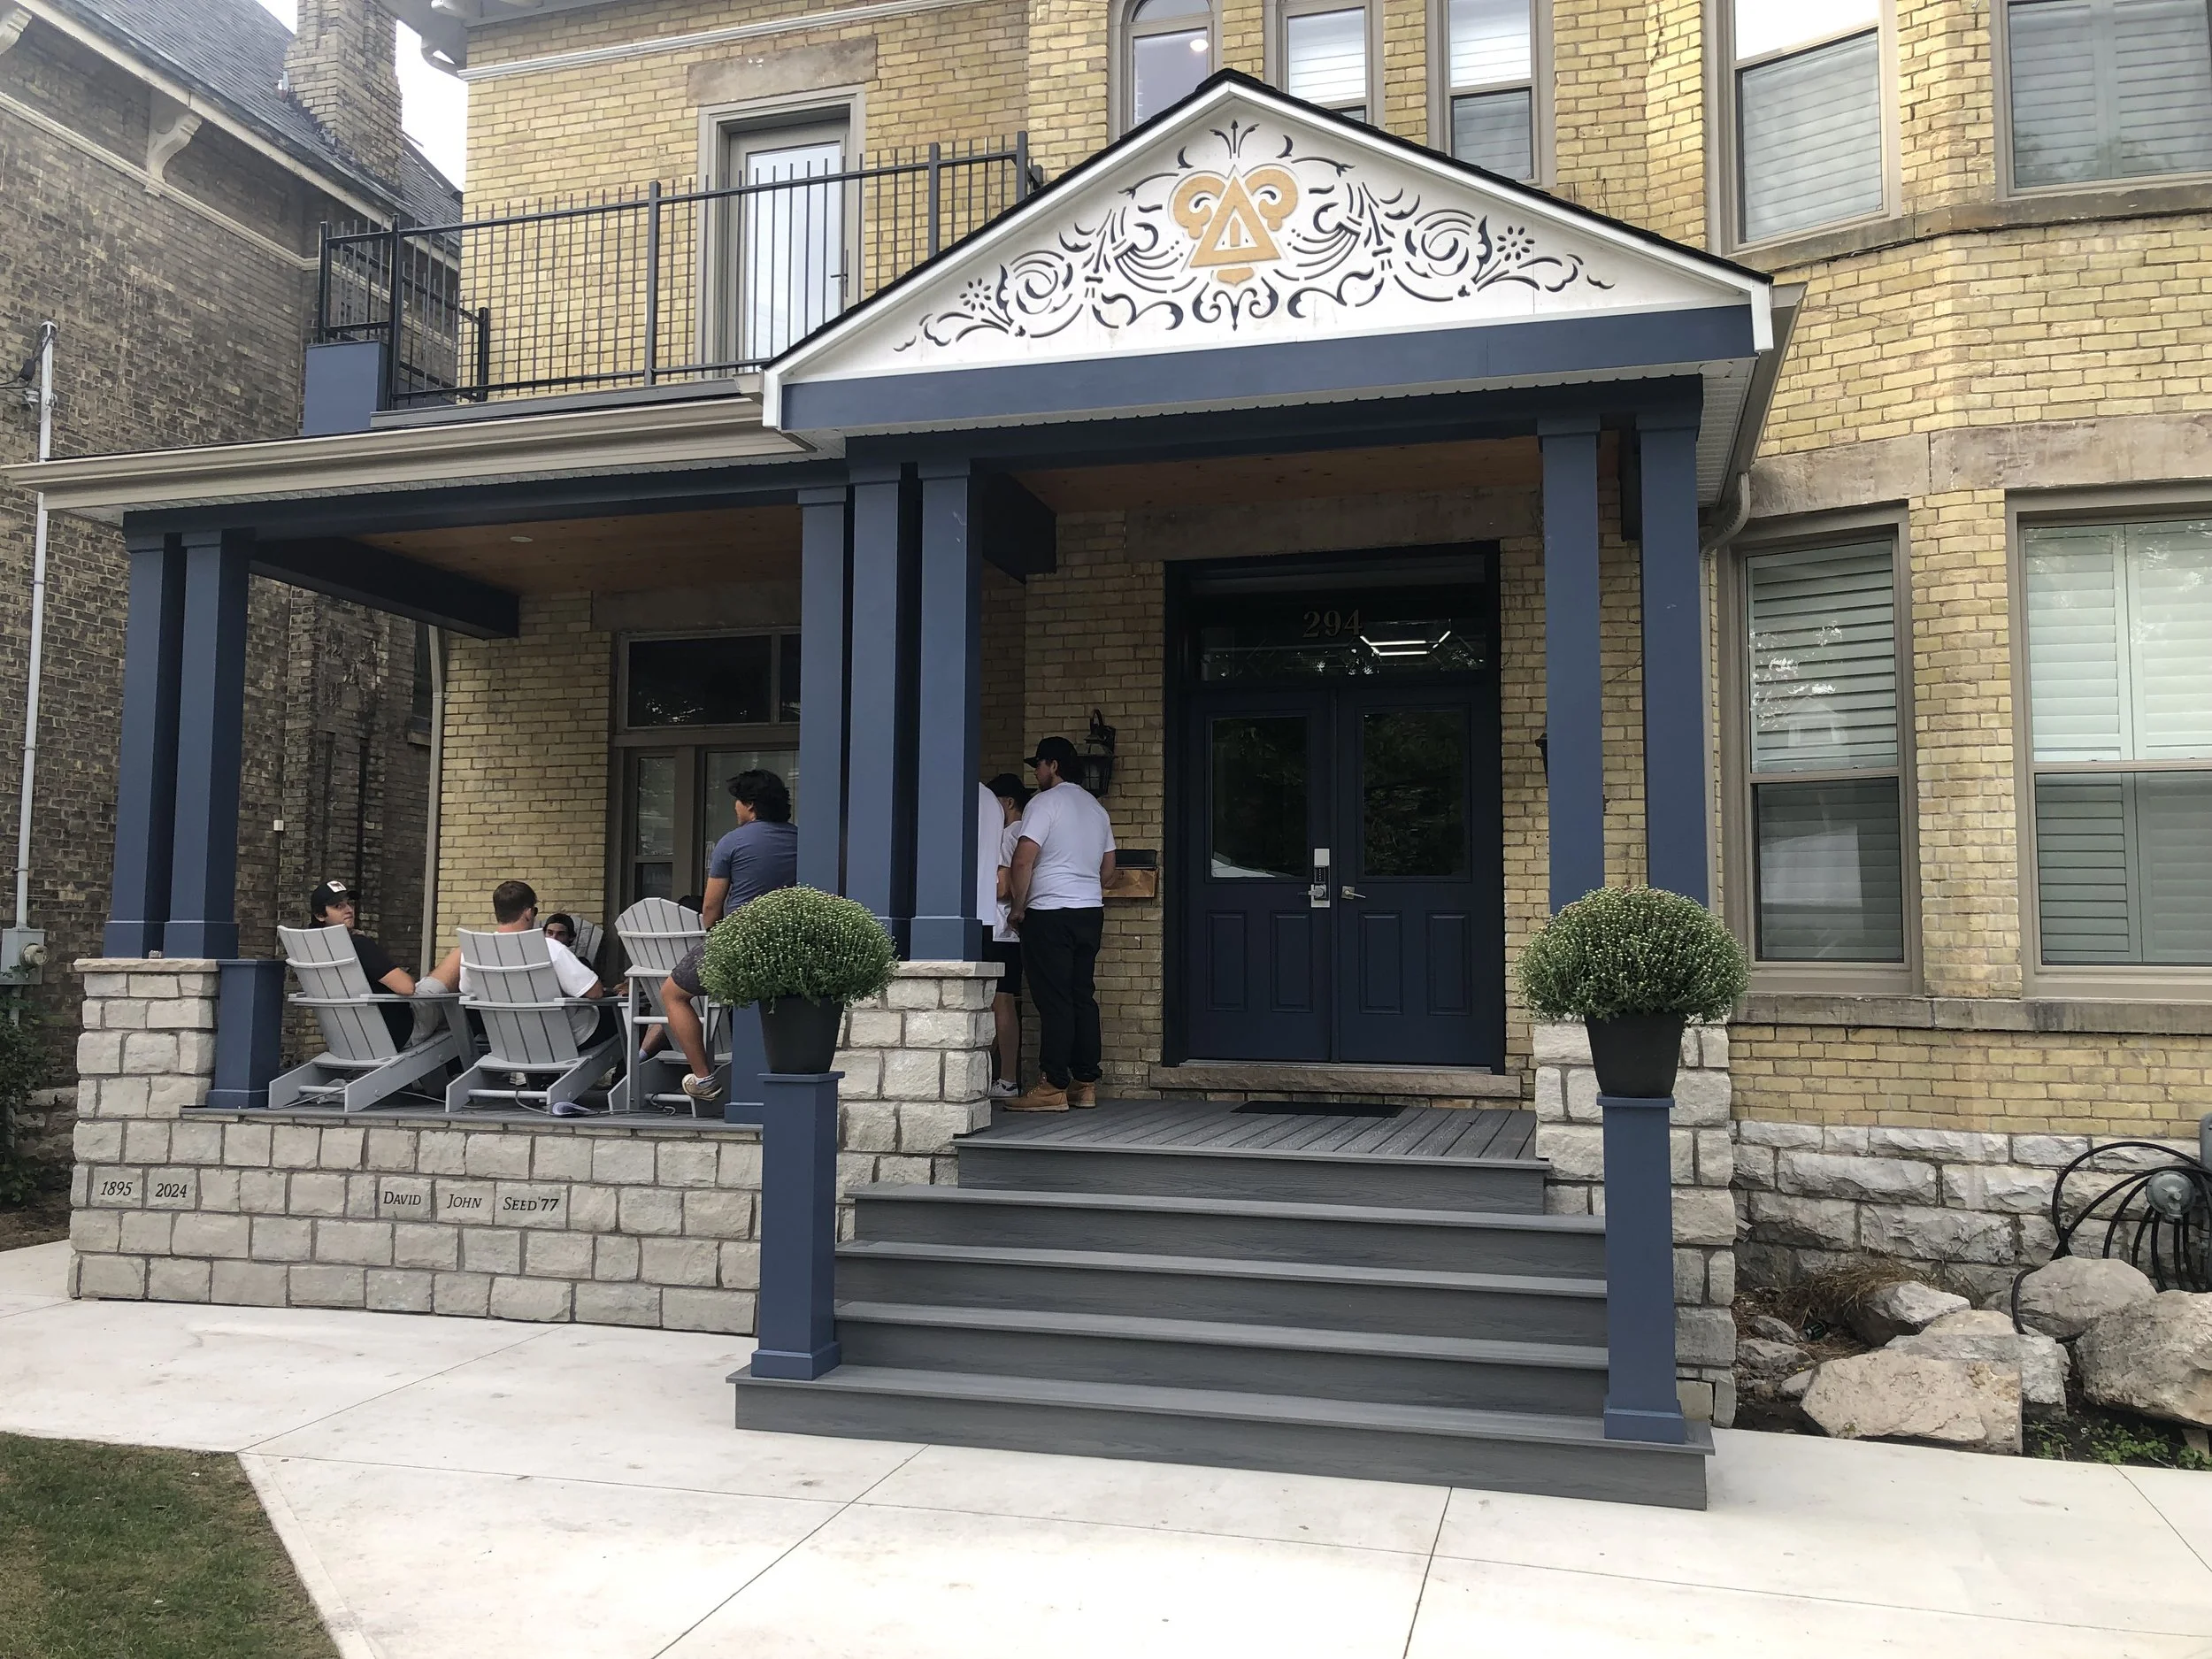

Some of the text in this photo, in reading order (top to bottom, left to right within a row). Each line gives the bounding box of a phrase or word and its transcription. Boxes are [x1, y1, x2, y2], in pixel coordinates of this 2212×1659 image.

[1302, 609, 1363, 639] 294
[99, 1181, 188, 1198] 1895 2024
